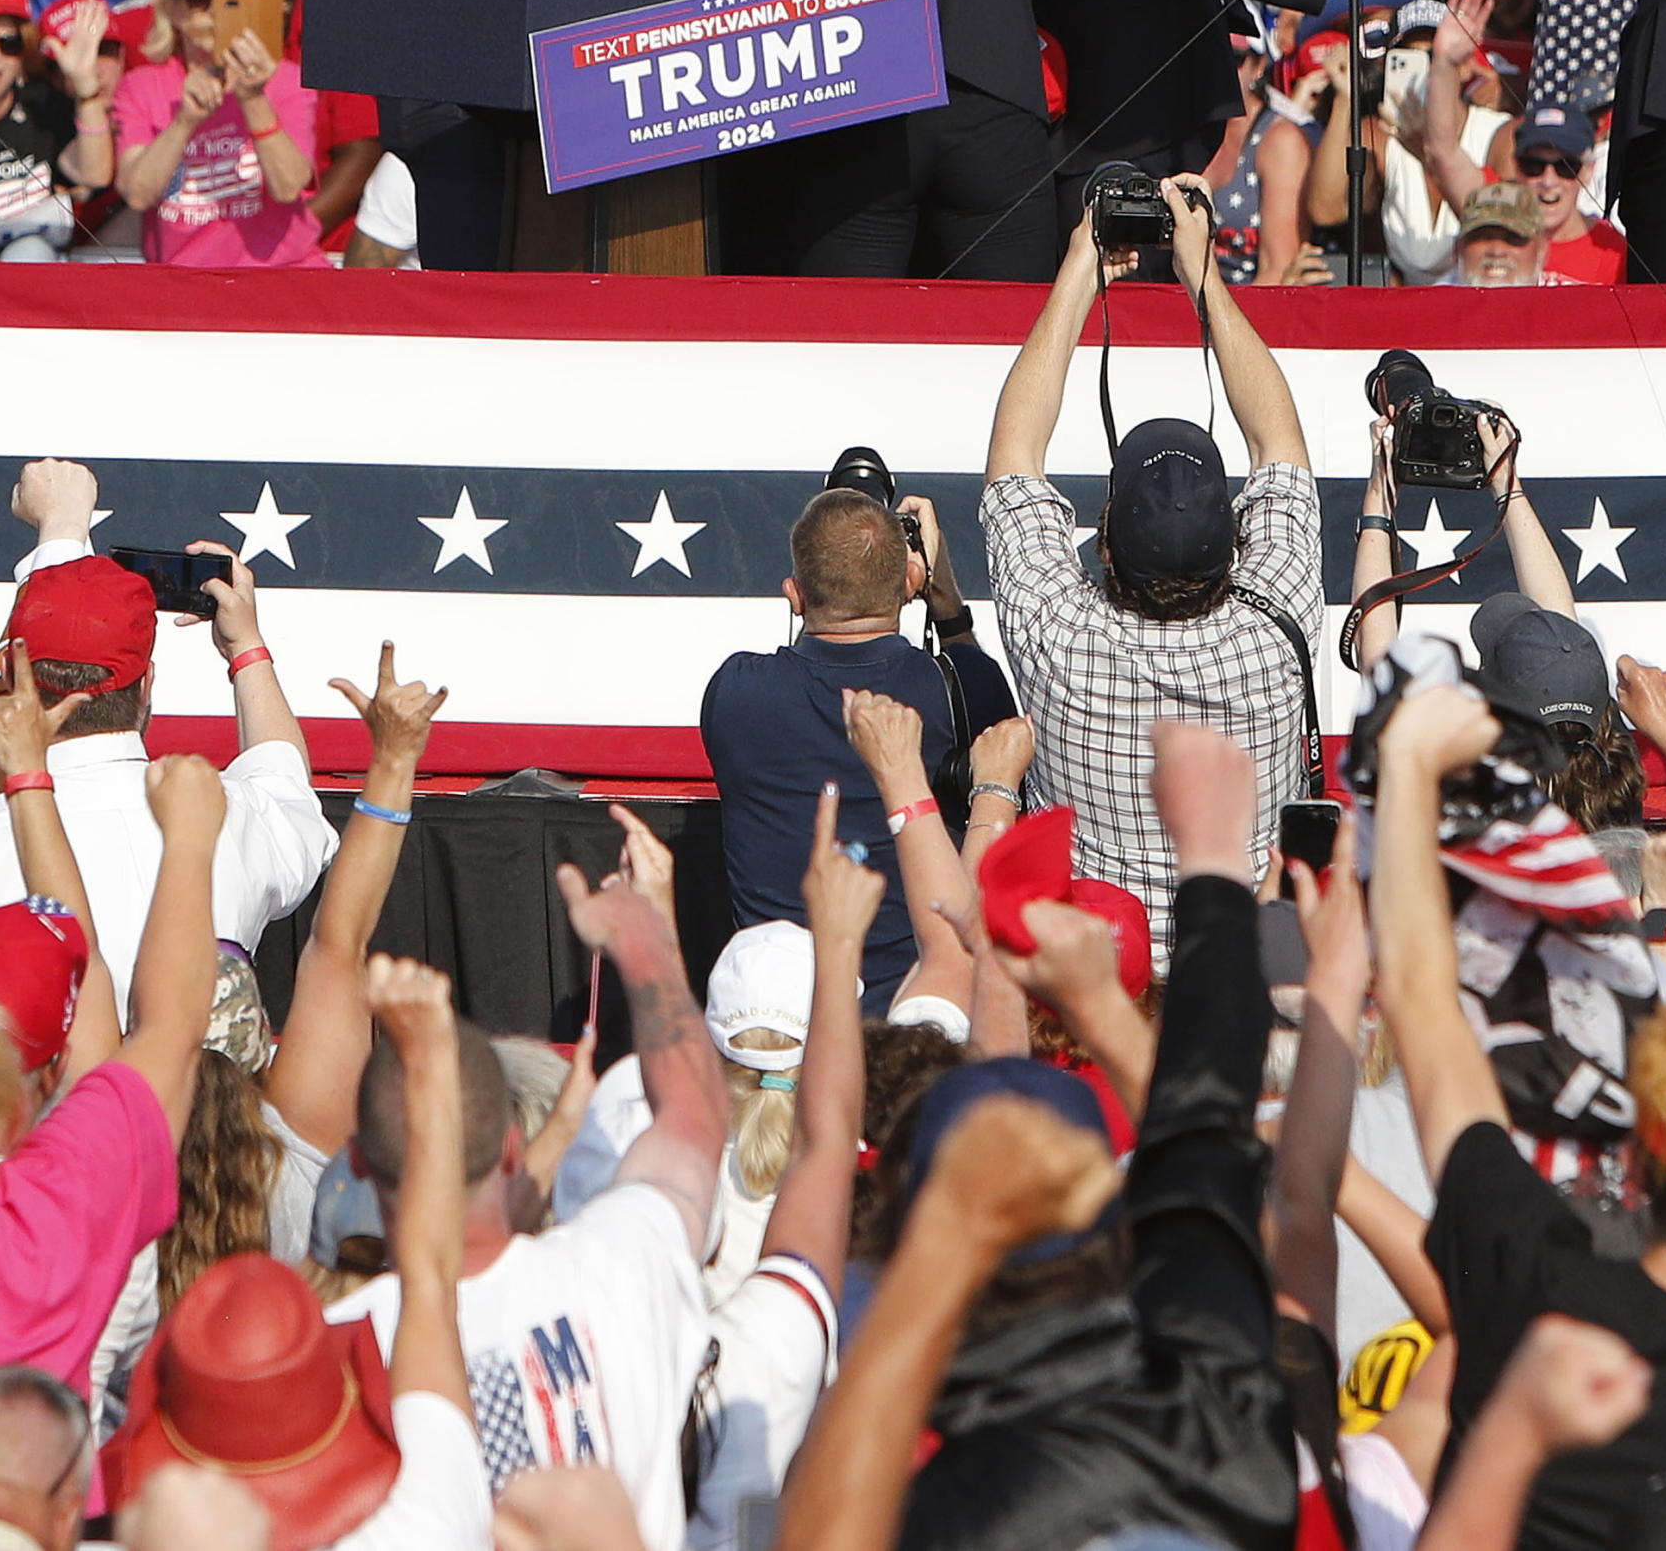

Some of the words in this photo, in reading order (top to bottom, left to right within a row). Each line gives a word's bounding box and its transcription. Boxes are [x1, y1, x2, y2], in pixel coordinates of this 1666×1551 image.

[581, 32, 632, 64] TEXT
[636, 3, 789, 52] PENNSYLVANIA
[609, 14, 864, 120] TRUMP
[630, 121, 673, 144] MAKE
[677, 105, 746, 135] AMERICA
[749, 92, 799, 117] GREAT
[803, 80, 857, 106] AGAIN!
[717, 119, 776, 151] 2024
[1234, 588, 1281, 618] SONY
[1342, 607, 1363, 656] Canon
